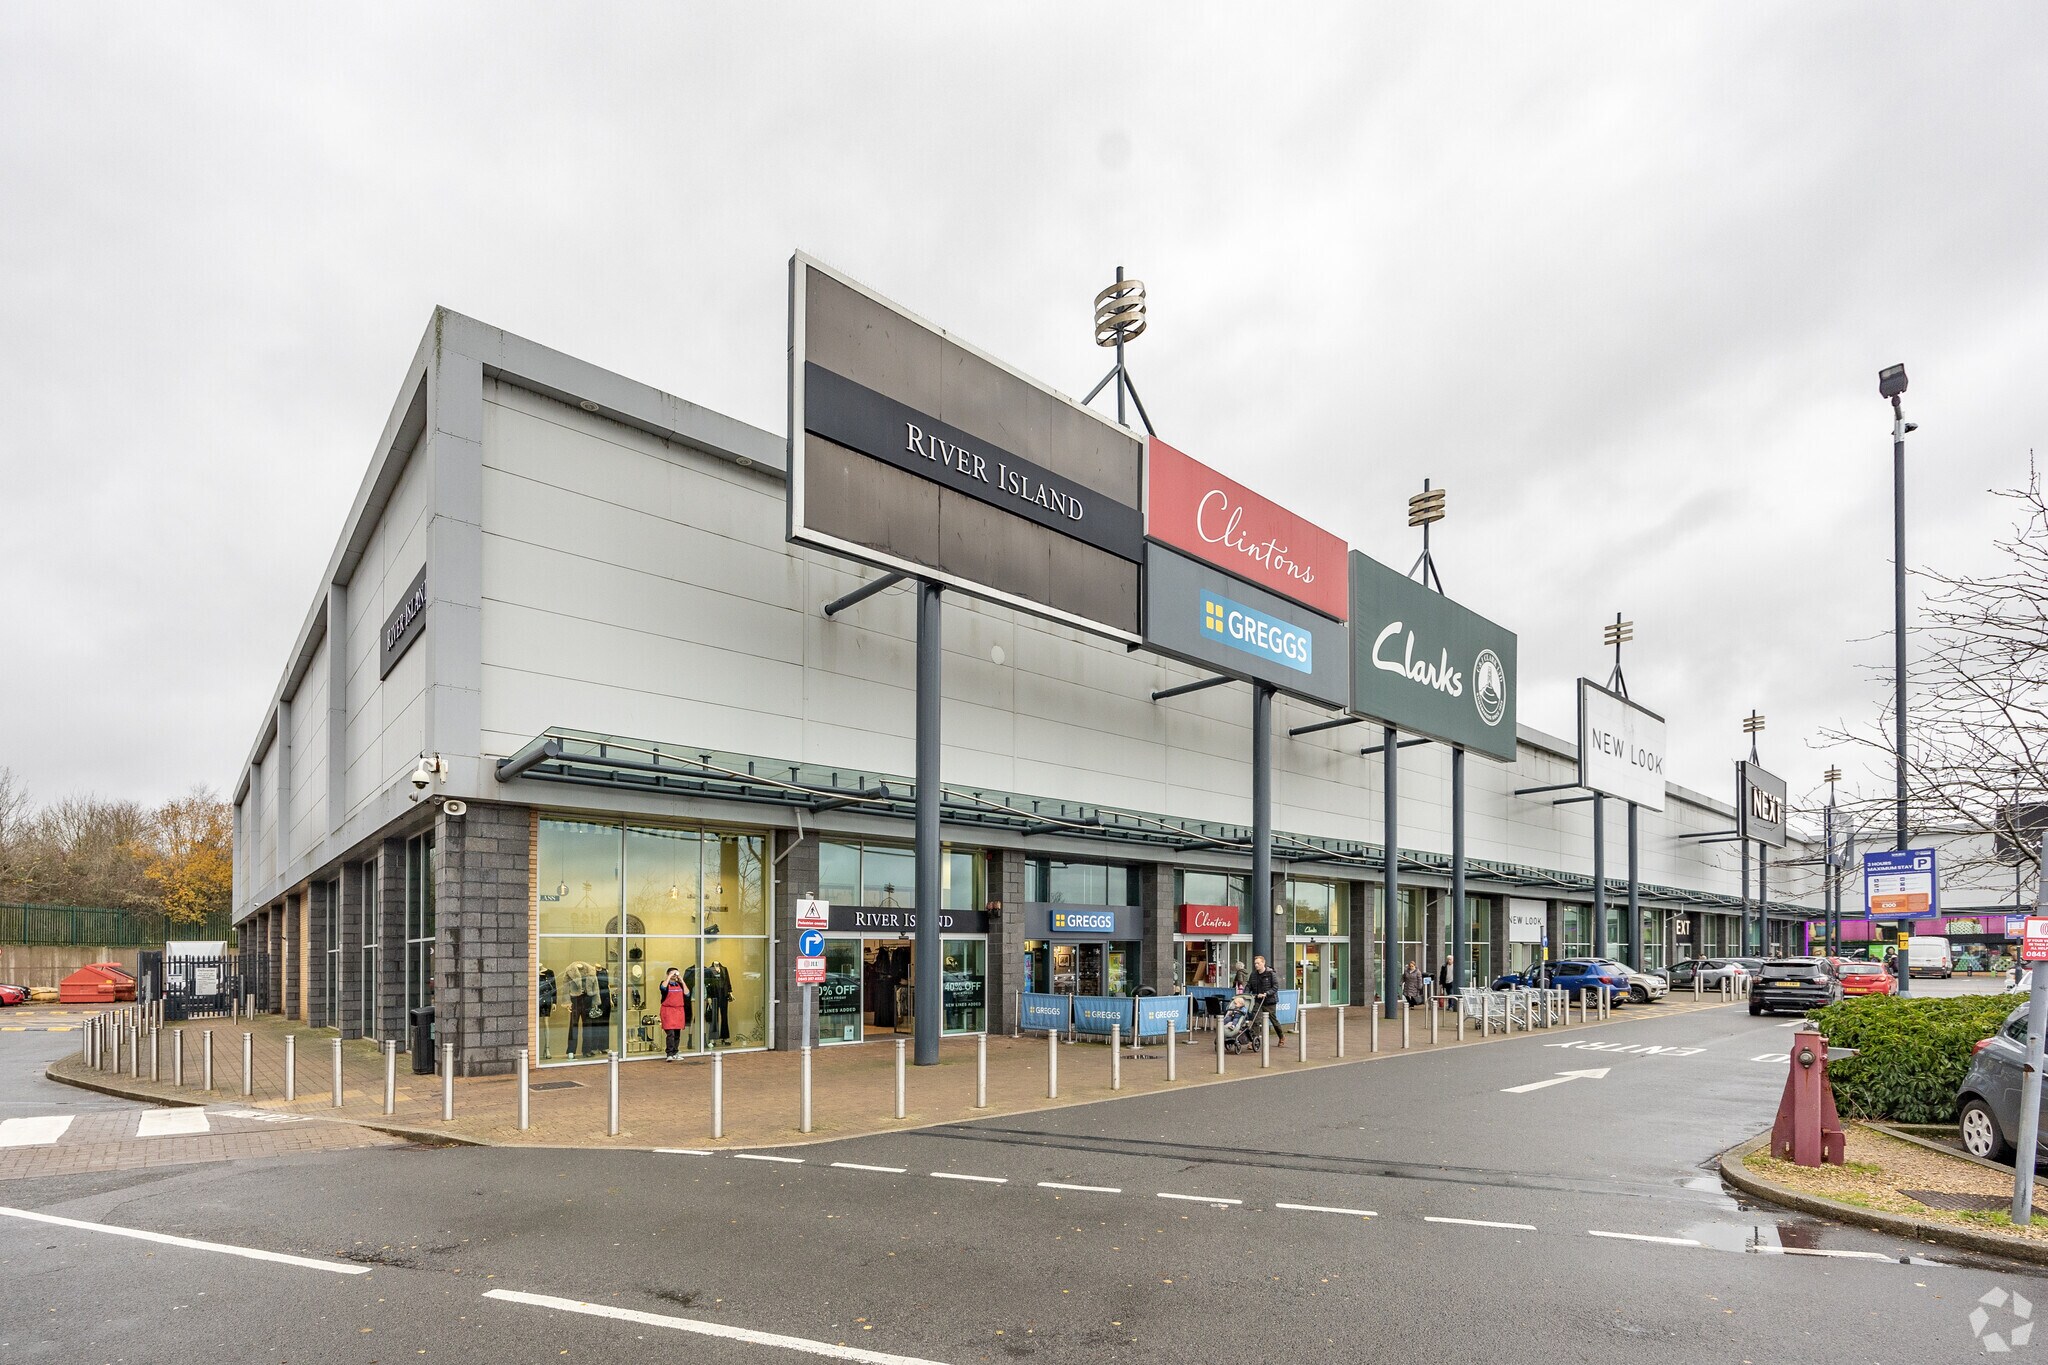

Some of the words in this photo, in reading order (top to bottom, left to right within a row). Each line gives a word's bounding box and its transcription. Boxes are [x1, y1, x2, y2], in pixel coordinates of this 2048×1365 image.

[905, 422, 989, 484] RIVER
[998, 462, 1084, 522] ISLAND
[1196, 489, 1315, 584] Clintons
[1228, 611, 1308, 664] GREGGS
[1372, 621, 1463, 698] Clarks
[1592, 727, 1625, 759] NEW
[1630, 744, 1663, 776] LOOK
[1752, 786, 1783, 825] NEXT
[1917, 858, 1928, 869] P
[855, 911, 900, 927] RIVER
[903, 912, 954, 928] ISND
[1067, 914, 1112, 929] GREGGS
[1194, 910, 1232, 928] Clintons
[1525, 916, 1542, 926] LOOK
[1676, 919, 1691, 935] EXT
[819, 985, 833, 996] 0%
[835, 984, 856, 995] OFF
[964, 981, 982, 991] OFF
[1035, 1006, 1061, 1016] GREGGS
[1091, 1010, 1121, 1020] GREGGS
[1154, 1009, 1180, 1019] GREGGS
[1543, 1040, 1708, 1057] ENTRY
